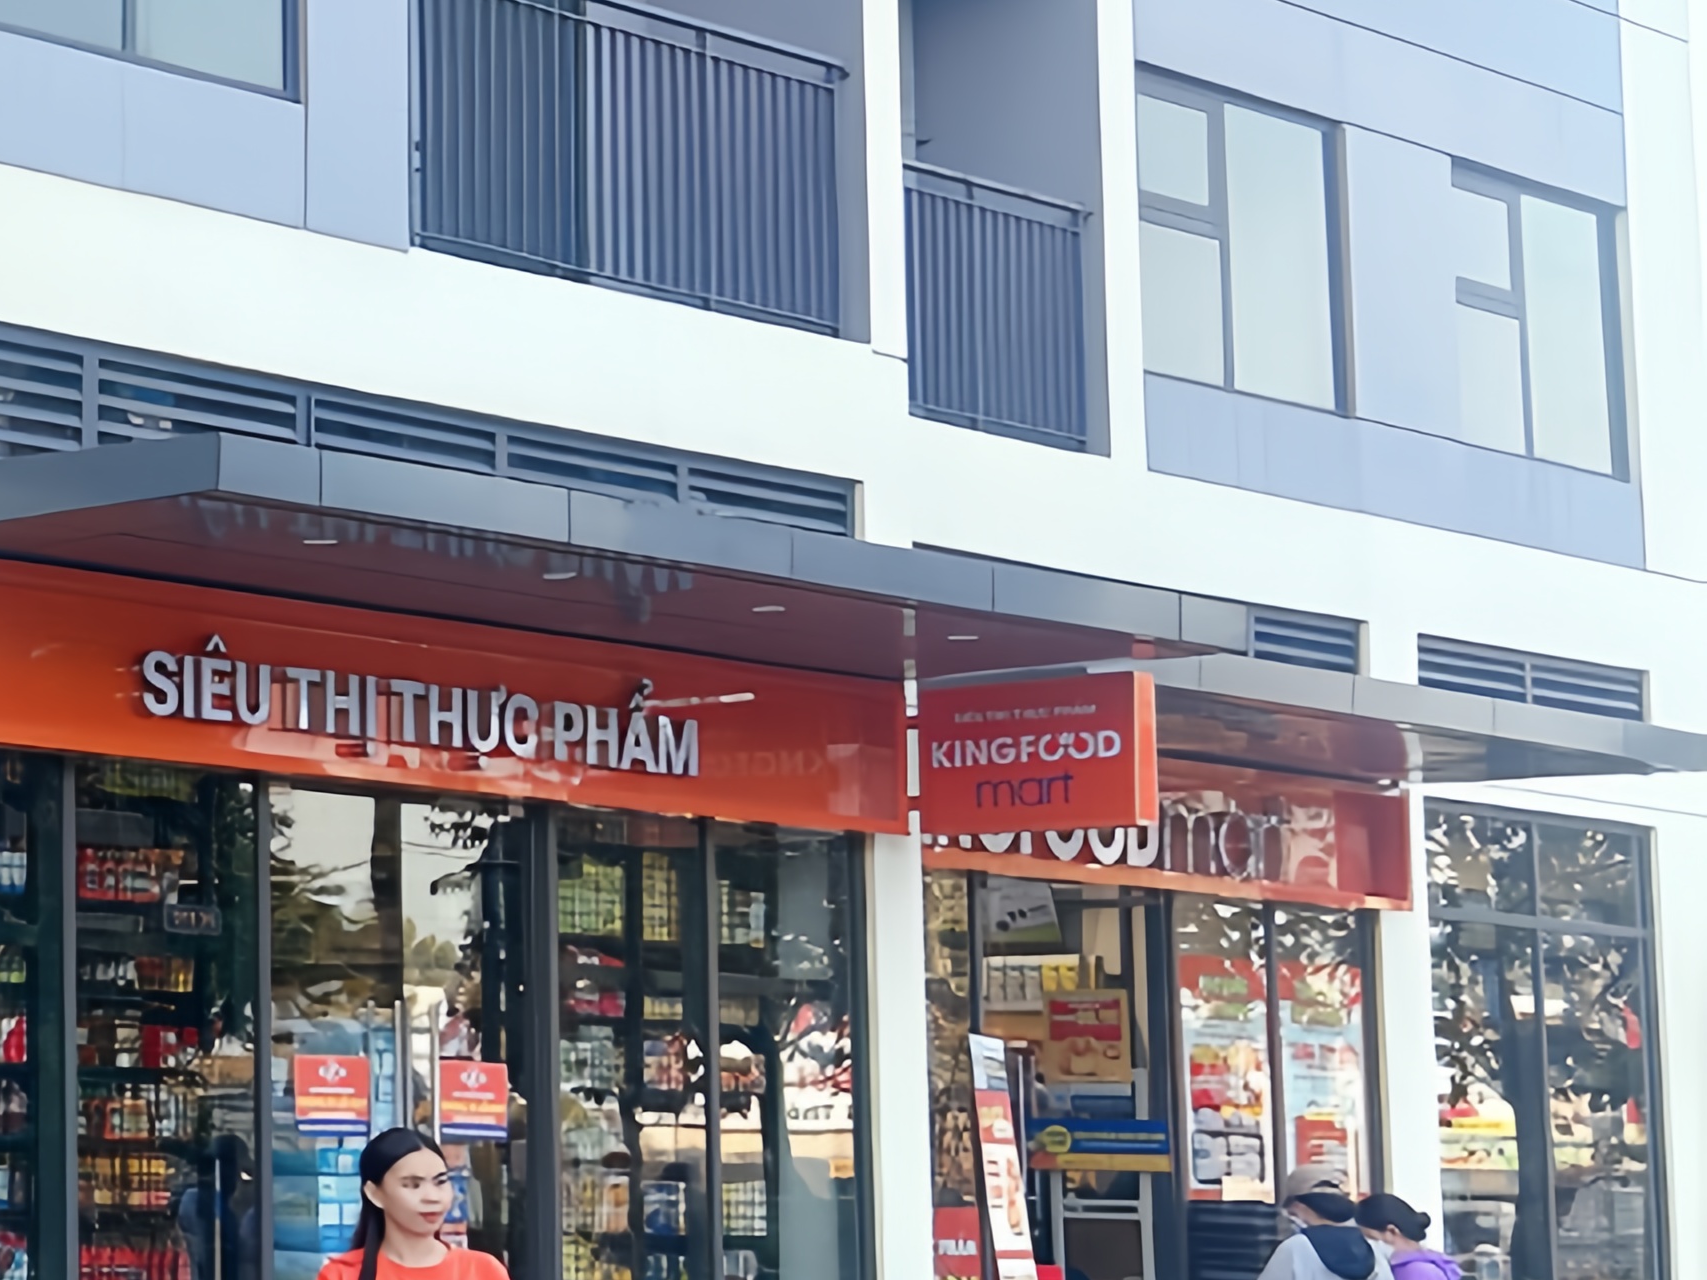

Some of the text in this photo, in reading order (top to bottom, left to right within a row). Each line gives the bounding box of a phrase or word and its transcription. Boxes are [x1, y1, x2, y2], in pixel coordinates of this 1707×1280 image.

[142, 634, 271, 725] SIÊU
[287, 666, 376, 750] THỊ
[554, 678, 699, 776] PHẨM
[931, 730, 1122, 768] KINGFOOD
[976, 770, 1074, 808] mart
